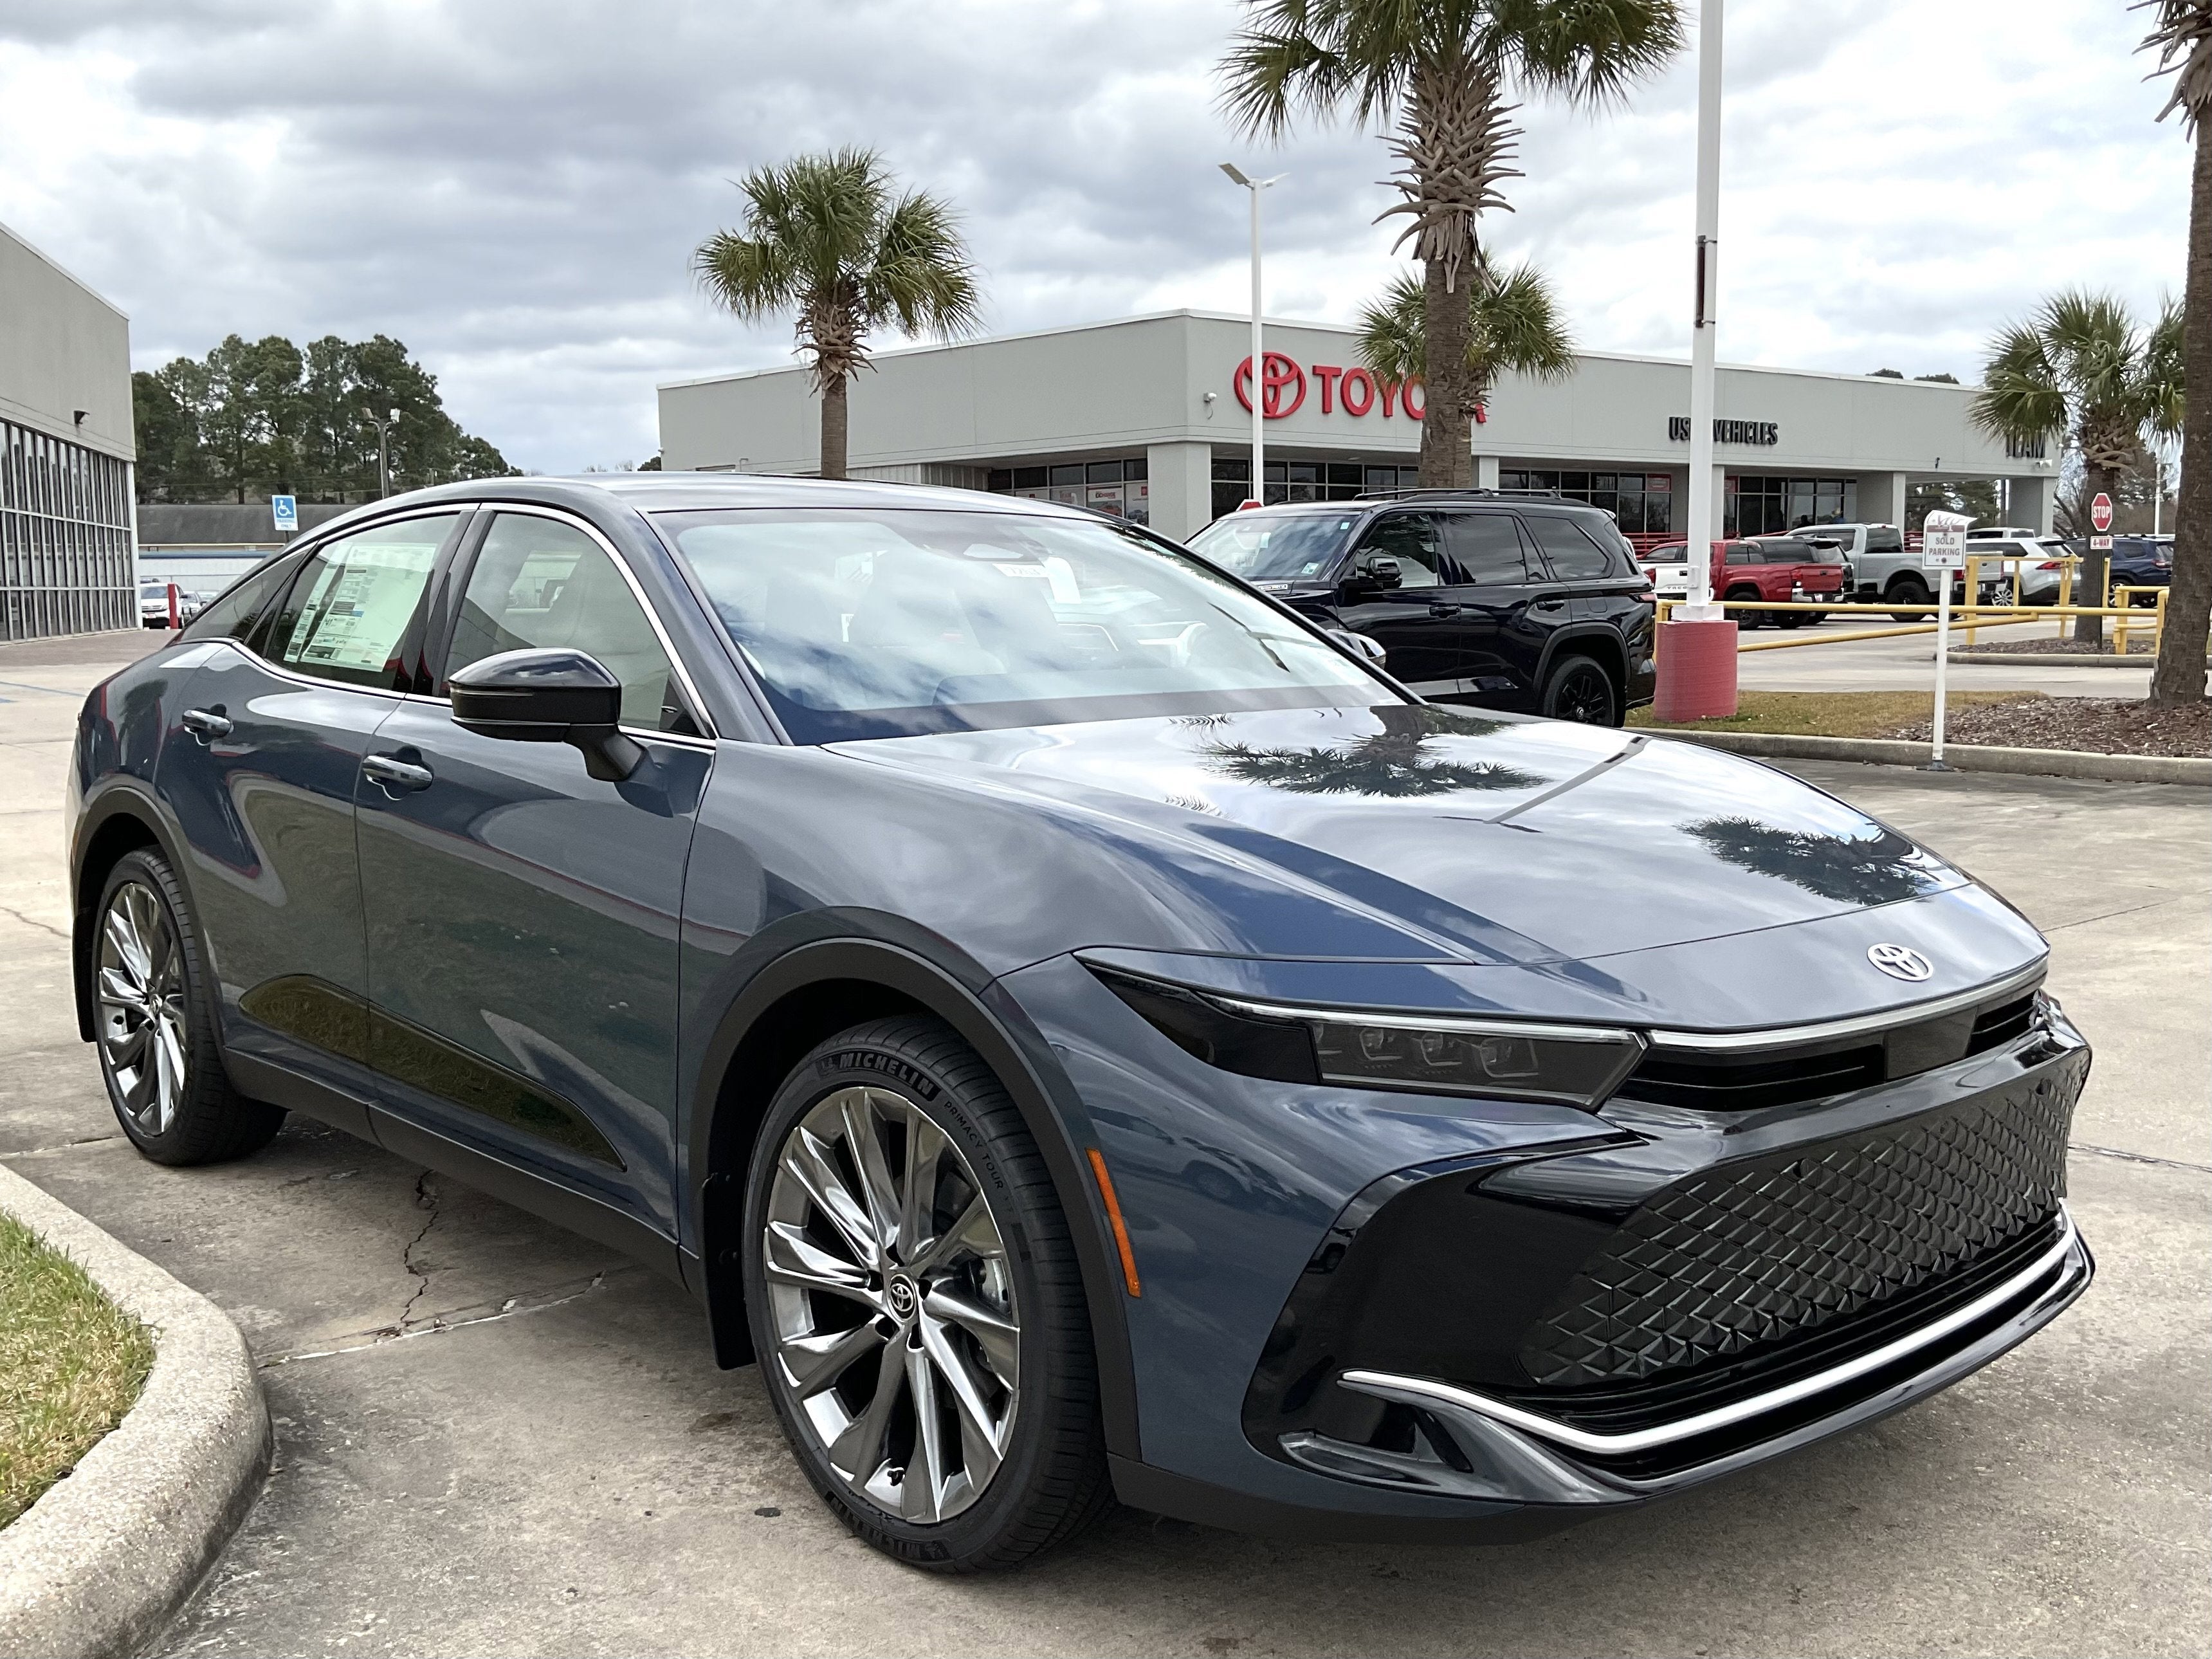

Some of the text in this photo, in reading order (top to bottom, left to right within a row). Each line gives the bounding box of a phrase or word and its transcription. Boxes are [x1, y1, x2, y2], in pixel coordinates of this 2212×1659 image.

[1312, 365, 1486, 423] TOYO
[1669, 417, 1778, 445] US VEHICLES
[2094, 506, 2110, 518] STOP
[2093, 538, 2110, 547] 4-WAY
[839, 1053, 935, 1096] MICHELIN
[944, 1101, 1004, 1189] PRIMACY TOUR
